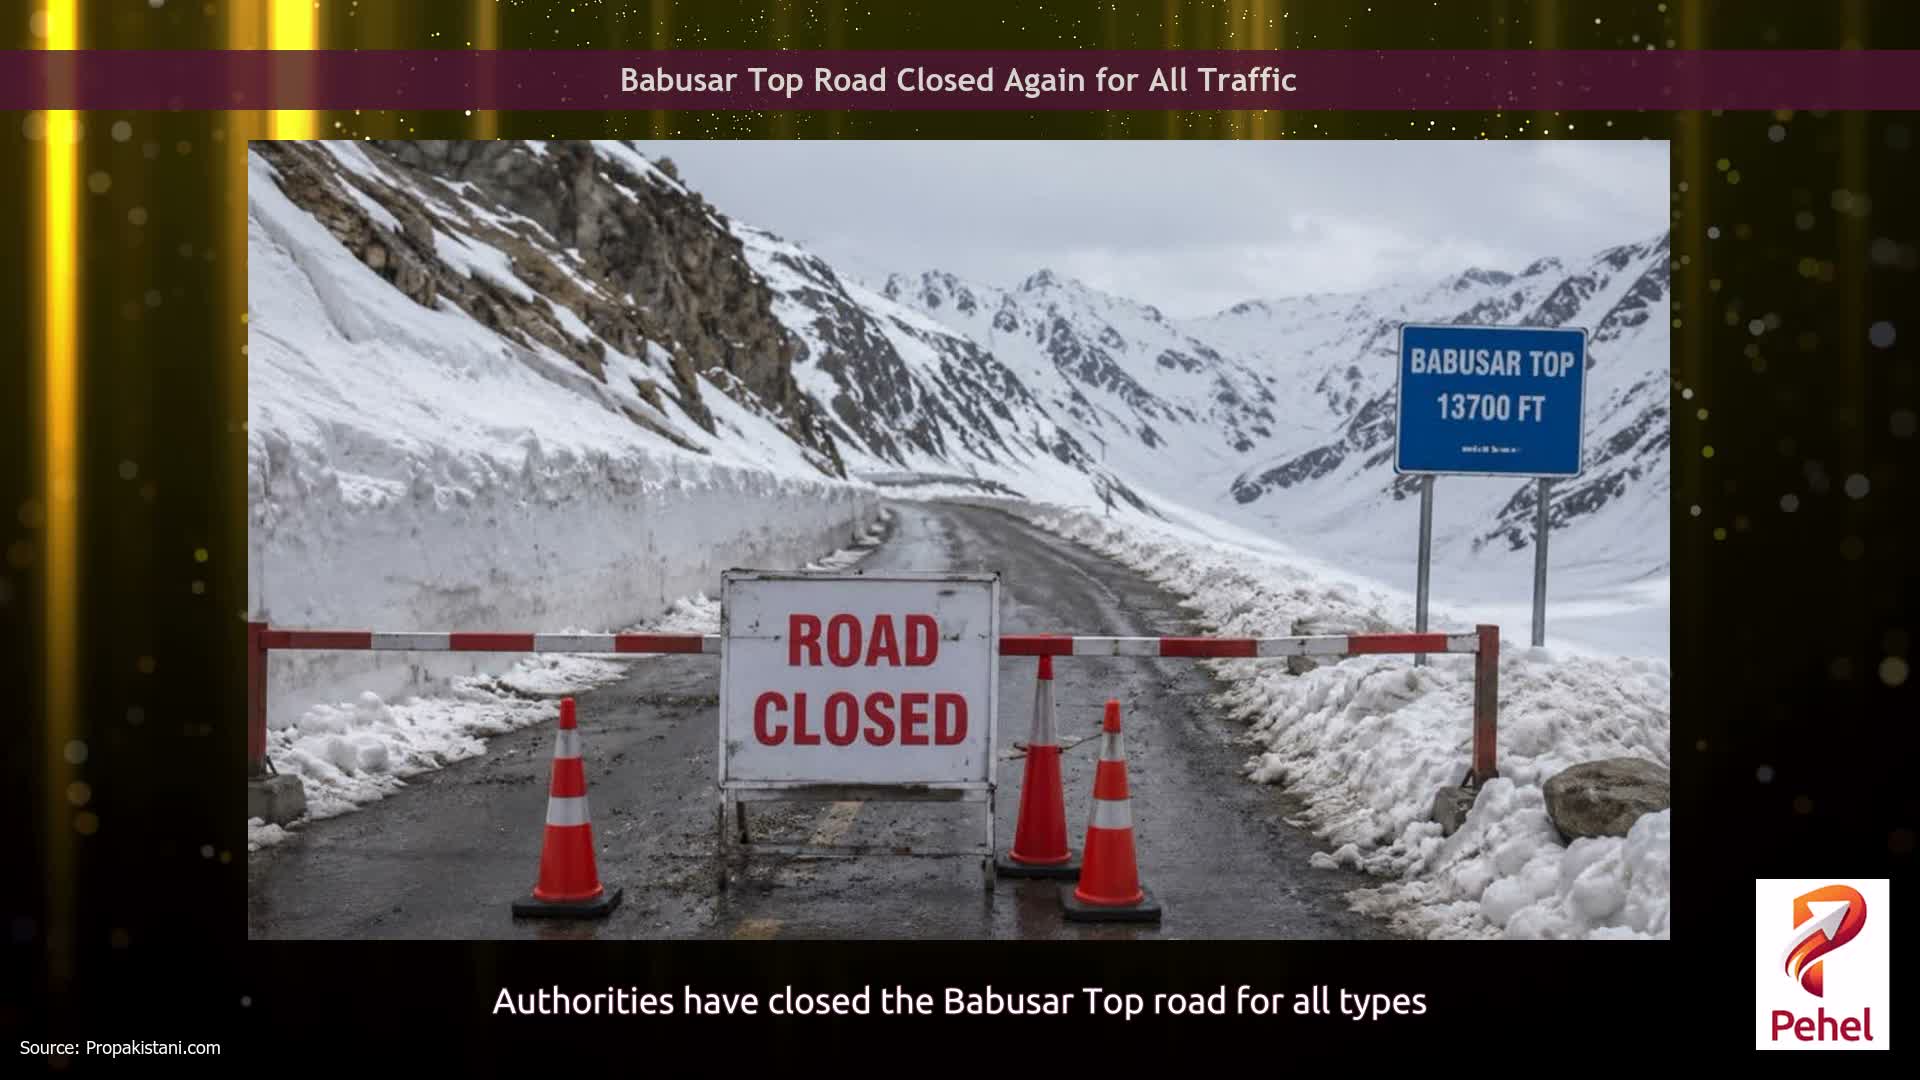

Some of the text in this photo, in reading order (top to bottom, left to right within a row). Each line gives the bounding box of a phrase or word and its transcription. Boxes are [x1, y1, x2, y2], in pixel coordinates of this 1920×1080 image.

[1411, 348, 1575, 377] BABUSAR TOP
[1437, 393, 1546, 422] 13700 FT
[788, 614, 939, 667] ROAD
[754, 691, 968, 746] CLOSED
